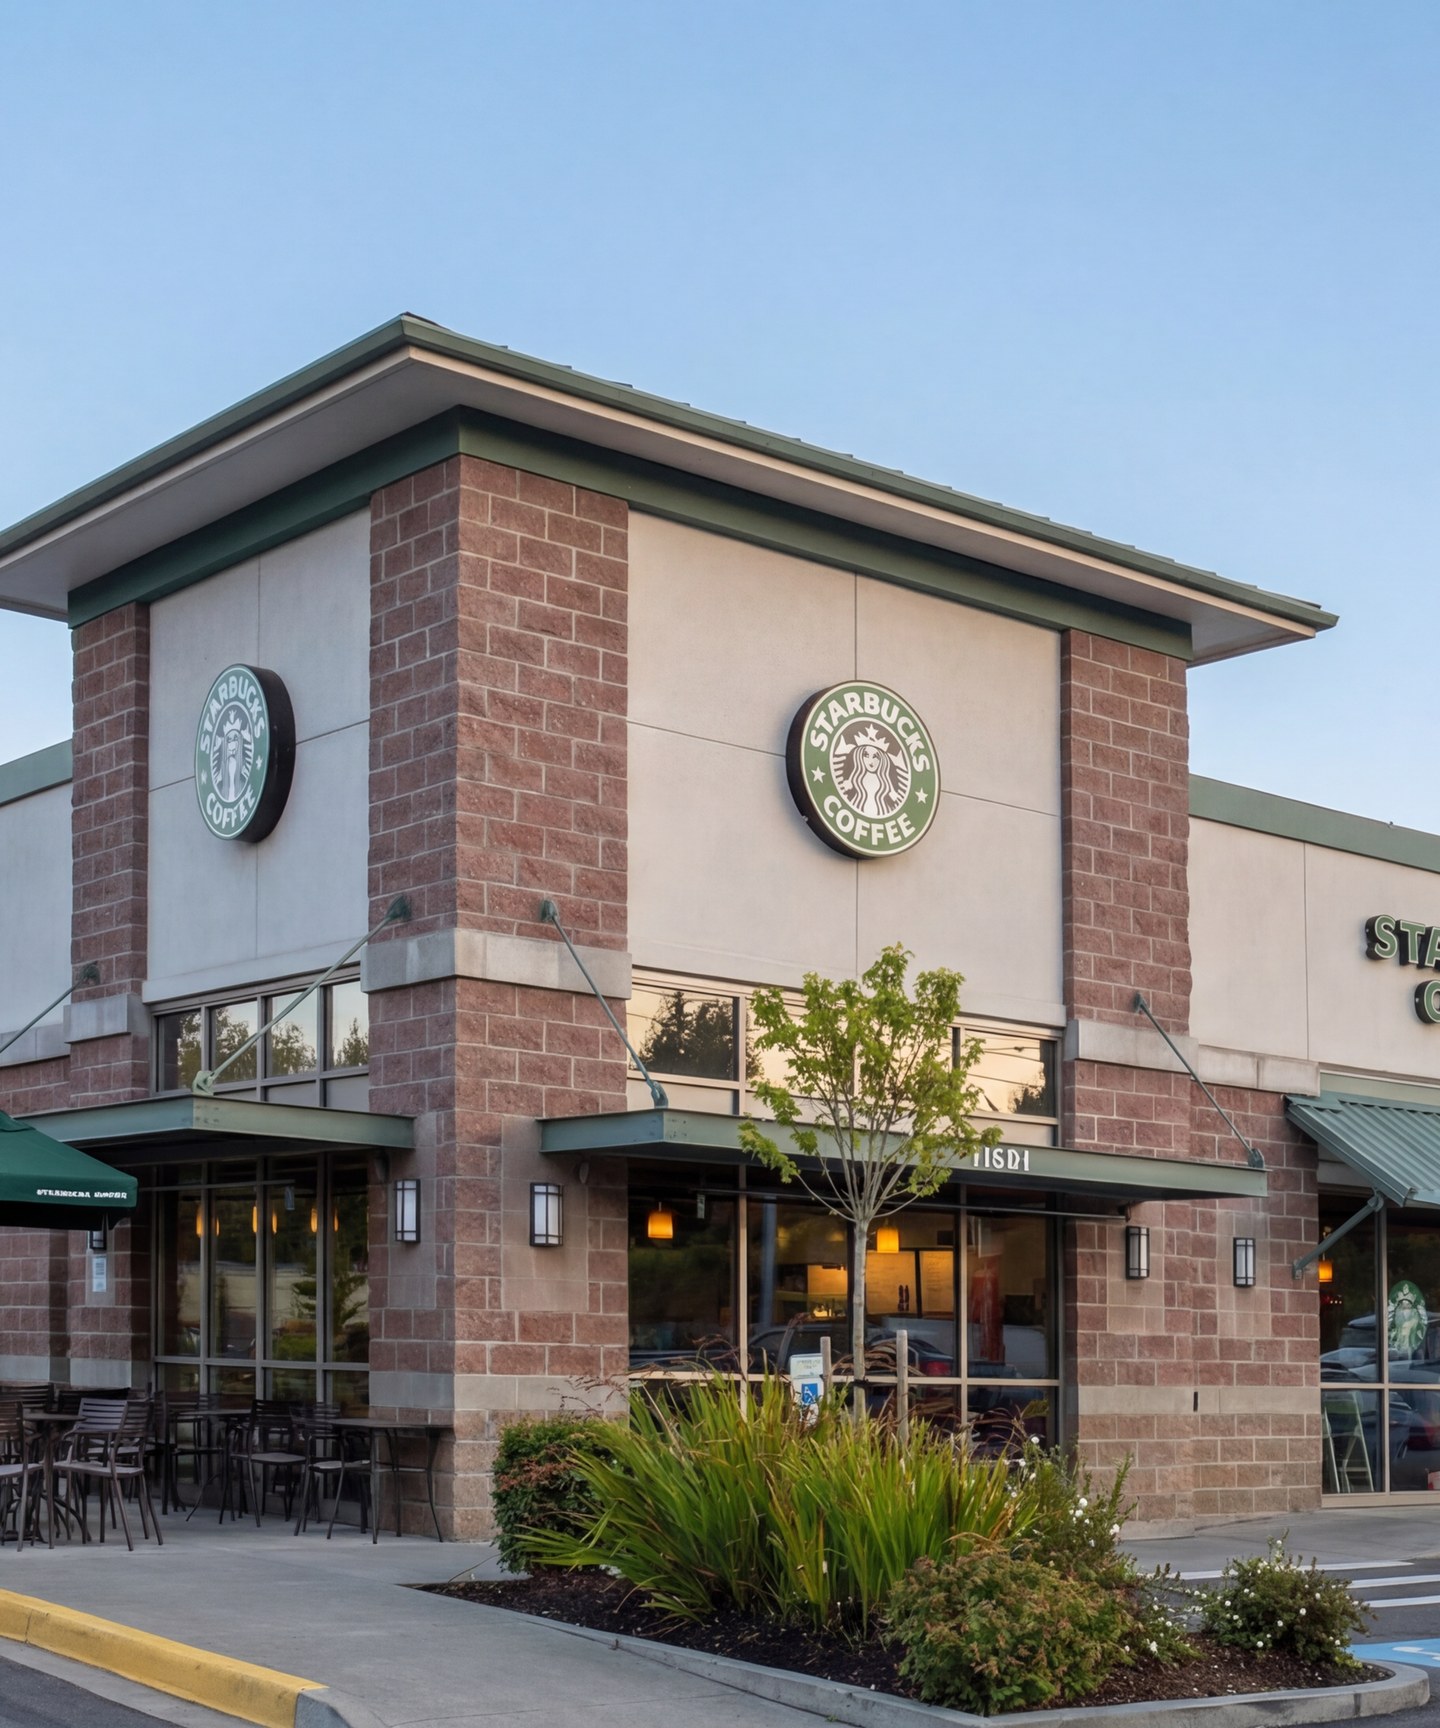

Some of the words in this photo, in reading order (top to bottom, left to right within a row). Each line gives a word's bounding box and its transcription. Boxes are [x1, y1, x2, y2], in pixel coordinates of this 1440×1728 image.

[200, 675, 265, 755] STARBUCKS
[810, 691, 931, 773] STARBUCKS
[205, 784, 256, 830] COFFEE
[823, 795, 916, 846] COFFEE
